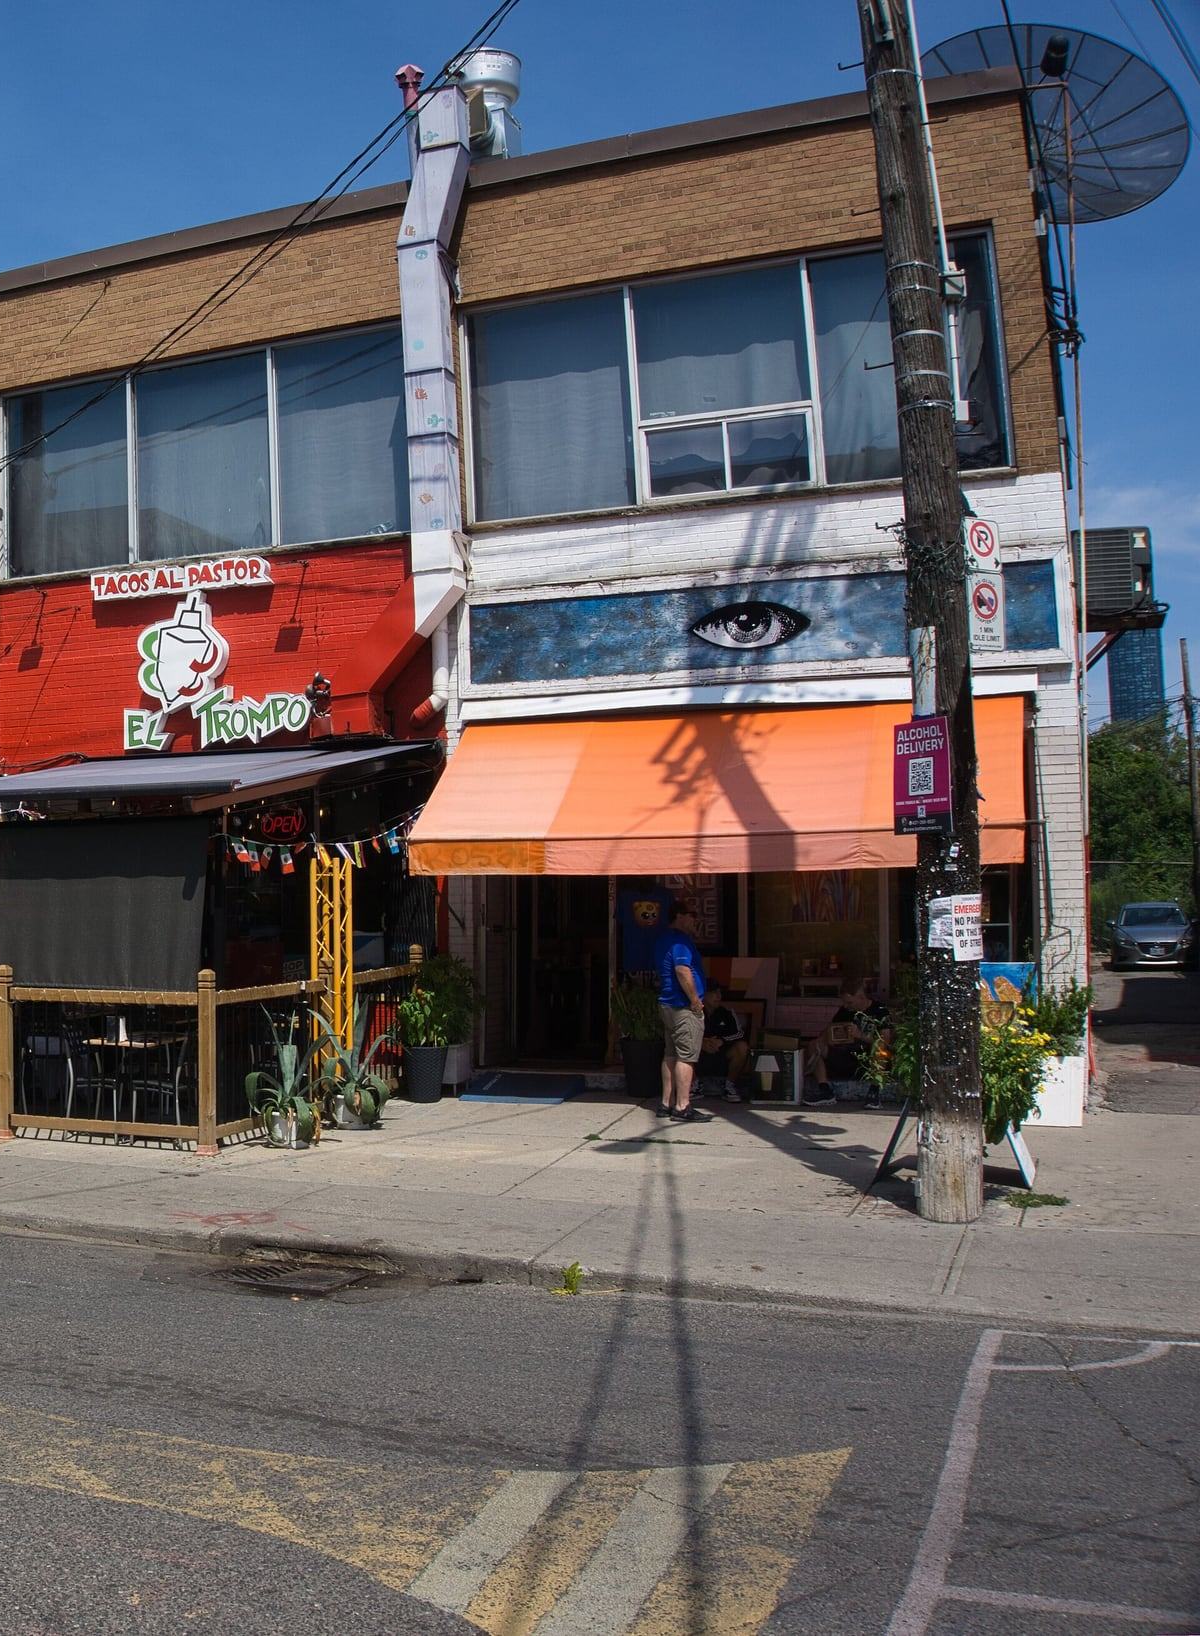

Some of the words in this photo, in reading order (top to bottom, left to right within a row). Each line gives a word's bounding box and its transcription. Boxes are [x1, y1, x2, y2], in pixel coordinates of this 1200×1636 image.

[94, 572, 149, 596] TACOS
[154, 570, 184, 590] AL
[188, 559, 262, 586] PASTOR
[128, 714, 163, 748] EL
[196, 689, 307, 743] TROMPO
[897, 725, 943, 742] ALCOHOL
[896, 738, 944, 755] DELIVERY
[262, 815, 302, 833] OPEN
[954, 904, 981, 914] EMERGE
[954, 917, 965, 926] NO
[955, 929, 965, 937] ON
[960, 940, 968, 948] OF
